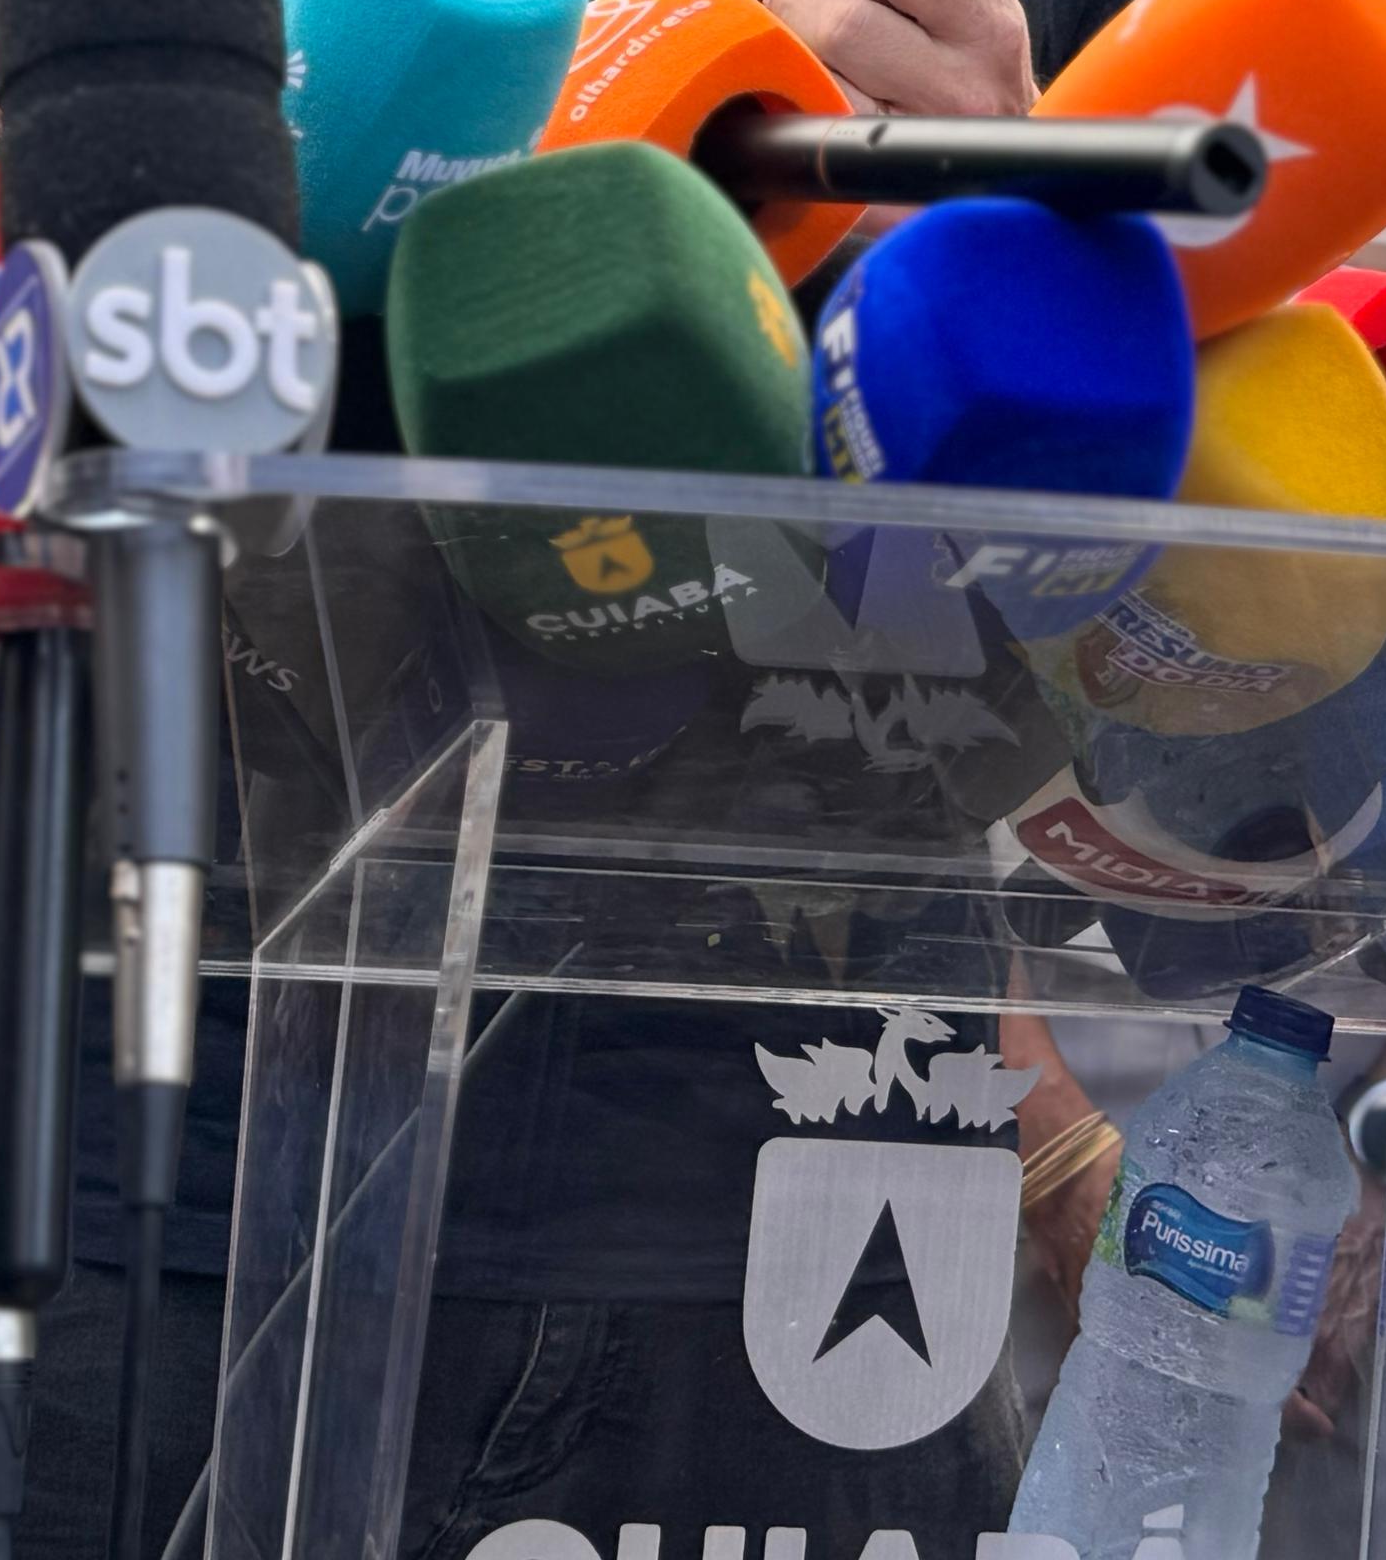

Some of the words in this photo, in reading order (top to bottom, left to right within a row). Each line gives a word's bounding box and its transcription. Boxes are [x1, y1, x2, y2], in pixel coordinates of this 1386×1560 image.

[569, 0, 712, 122] olhardireto
[86, 246, 318, 413] sbt
[526, 563, 754, 632] CUIABÁ
[1141, 1210, 1251, 1274] Purissima
